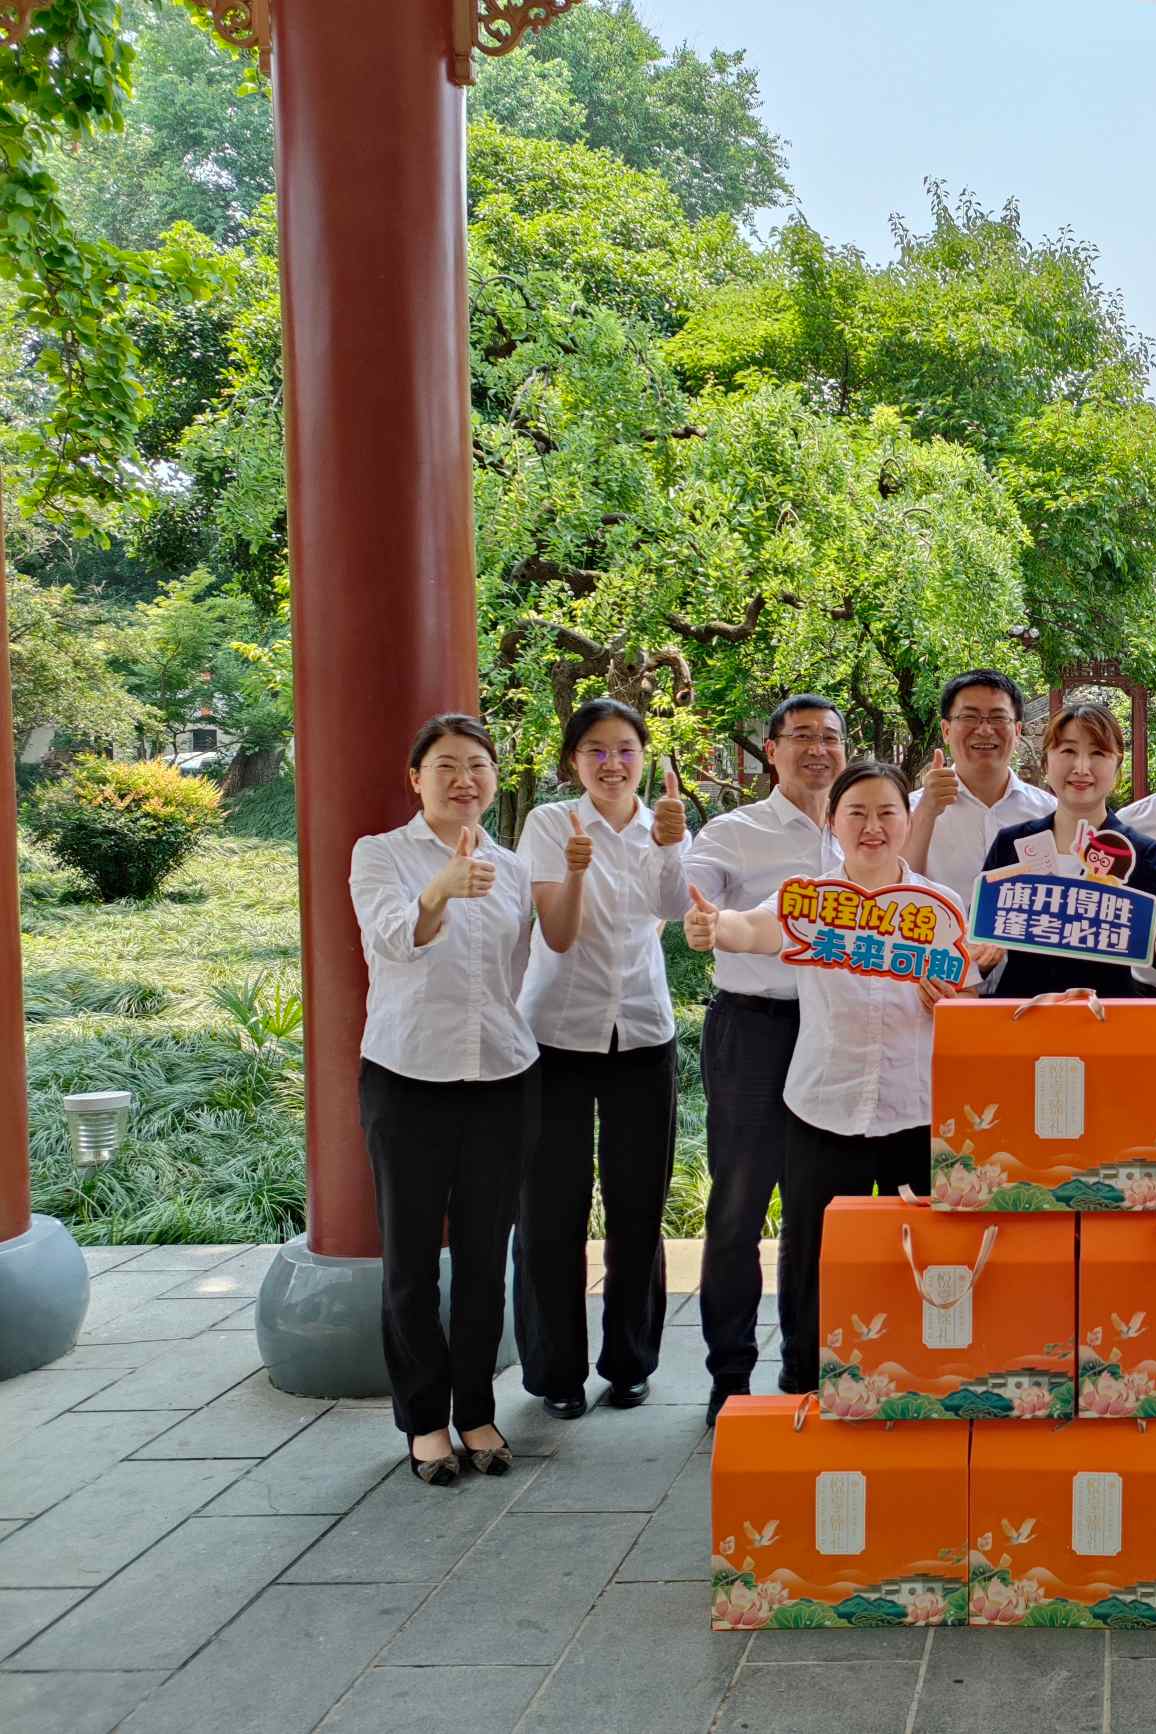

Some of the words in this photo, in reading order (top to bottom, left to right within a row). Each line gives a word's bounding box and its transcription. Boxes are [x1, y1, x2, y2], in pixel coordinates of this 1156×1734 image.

[781, 884, 938, 944] 前程似锦
[997, 882, 1134, 926] 旗开得胜
[811, 928, 964, 983] 未来可期
[993, 910, 1131, 954] 逢考必过
